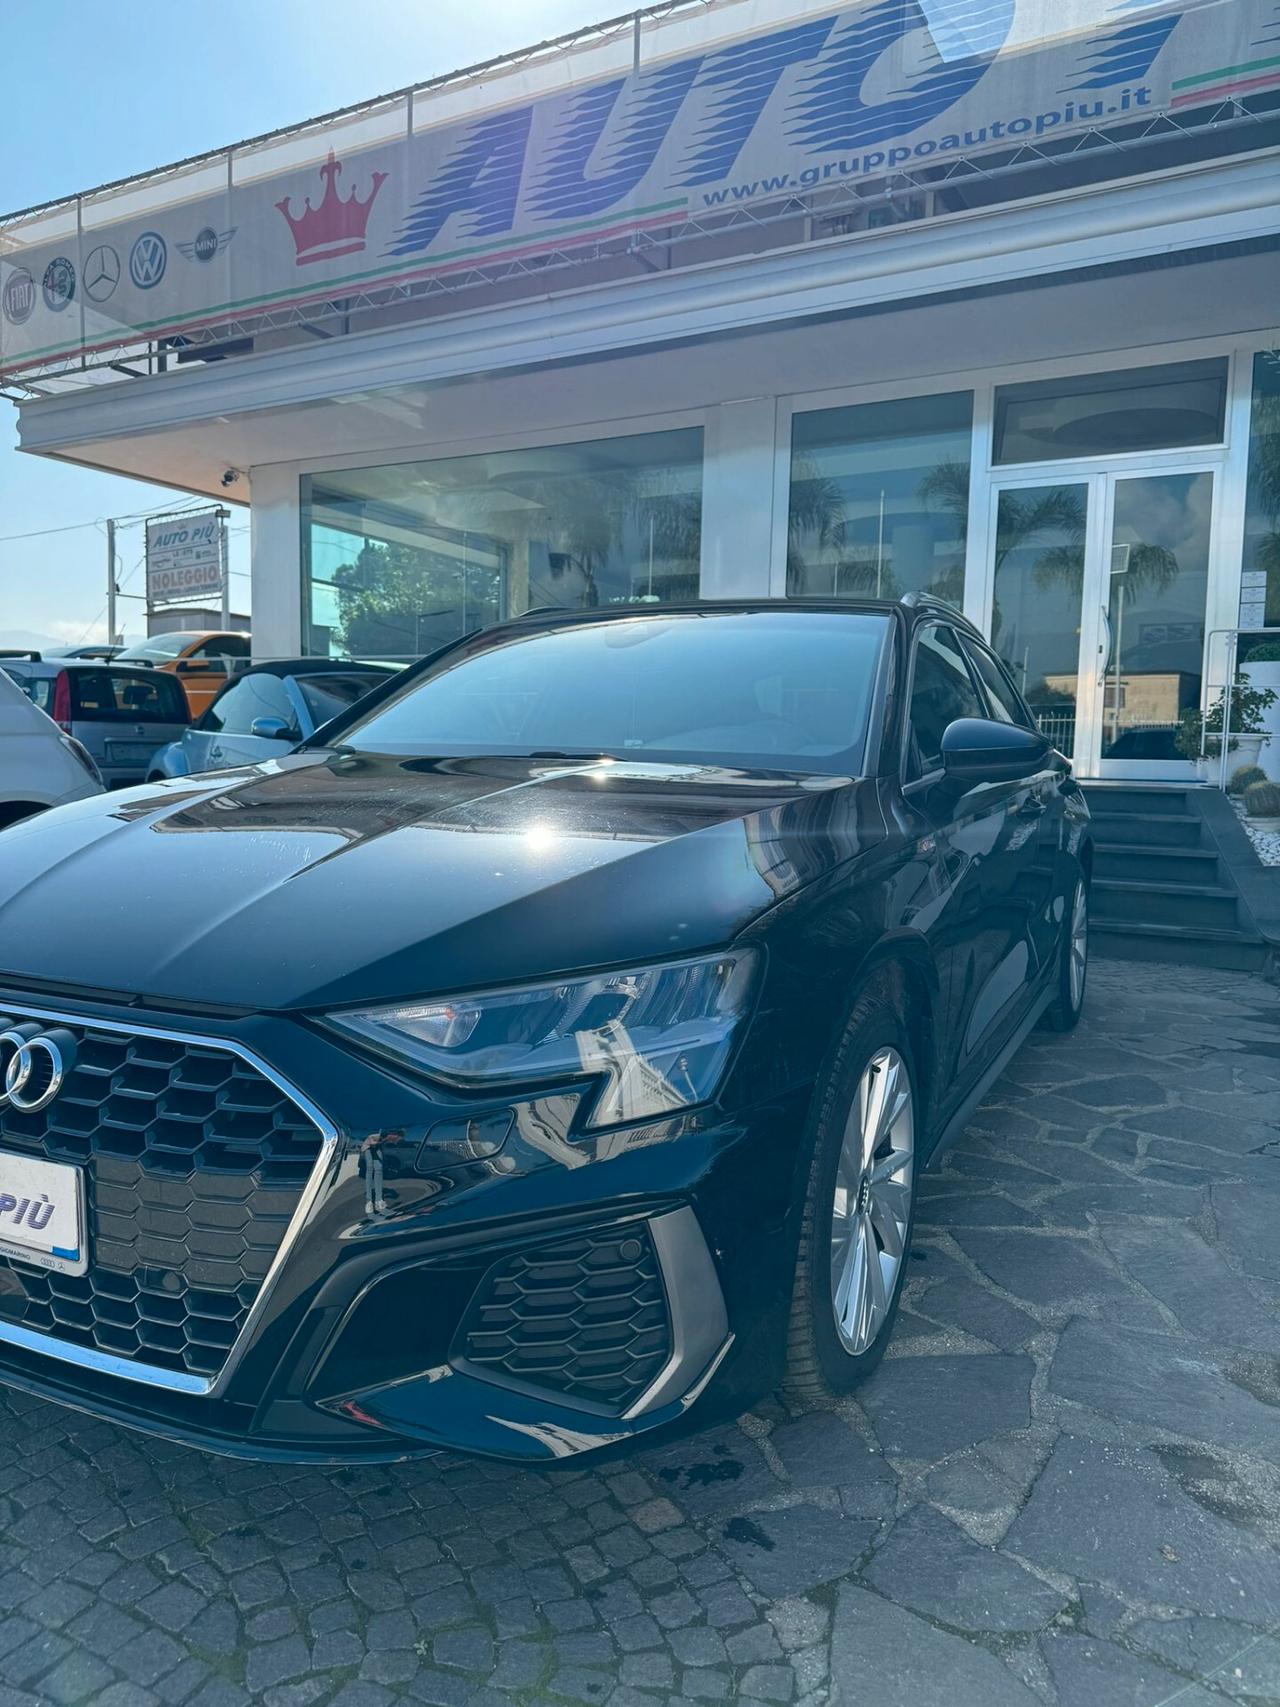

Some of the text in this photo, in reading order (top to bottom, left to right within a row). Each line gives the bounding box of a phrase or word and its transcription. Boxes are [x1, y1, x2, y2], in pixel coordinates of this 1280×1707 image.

[382, 0, 1016, 258] AUTO
[702, 86, 1152, 207] www.gruppoautopiu.it
[196, 238, 217, 252] MINI
[10, 282, 32, 311] FIAT
[153, 521, 216, 548] AUTO PIÙ
[151, 565, 218, 590] NOLEGGIO
[0, 1193, 56, 1230] PIÙ
